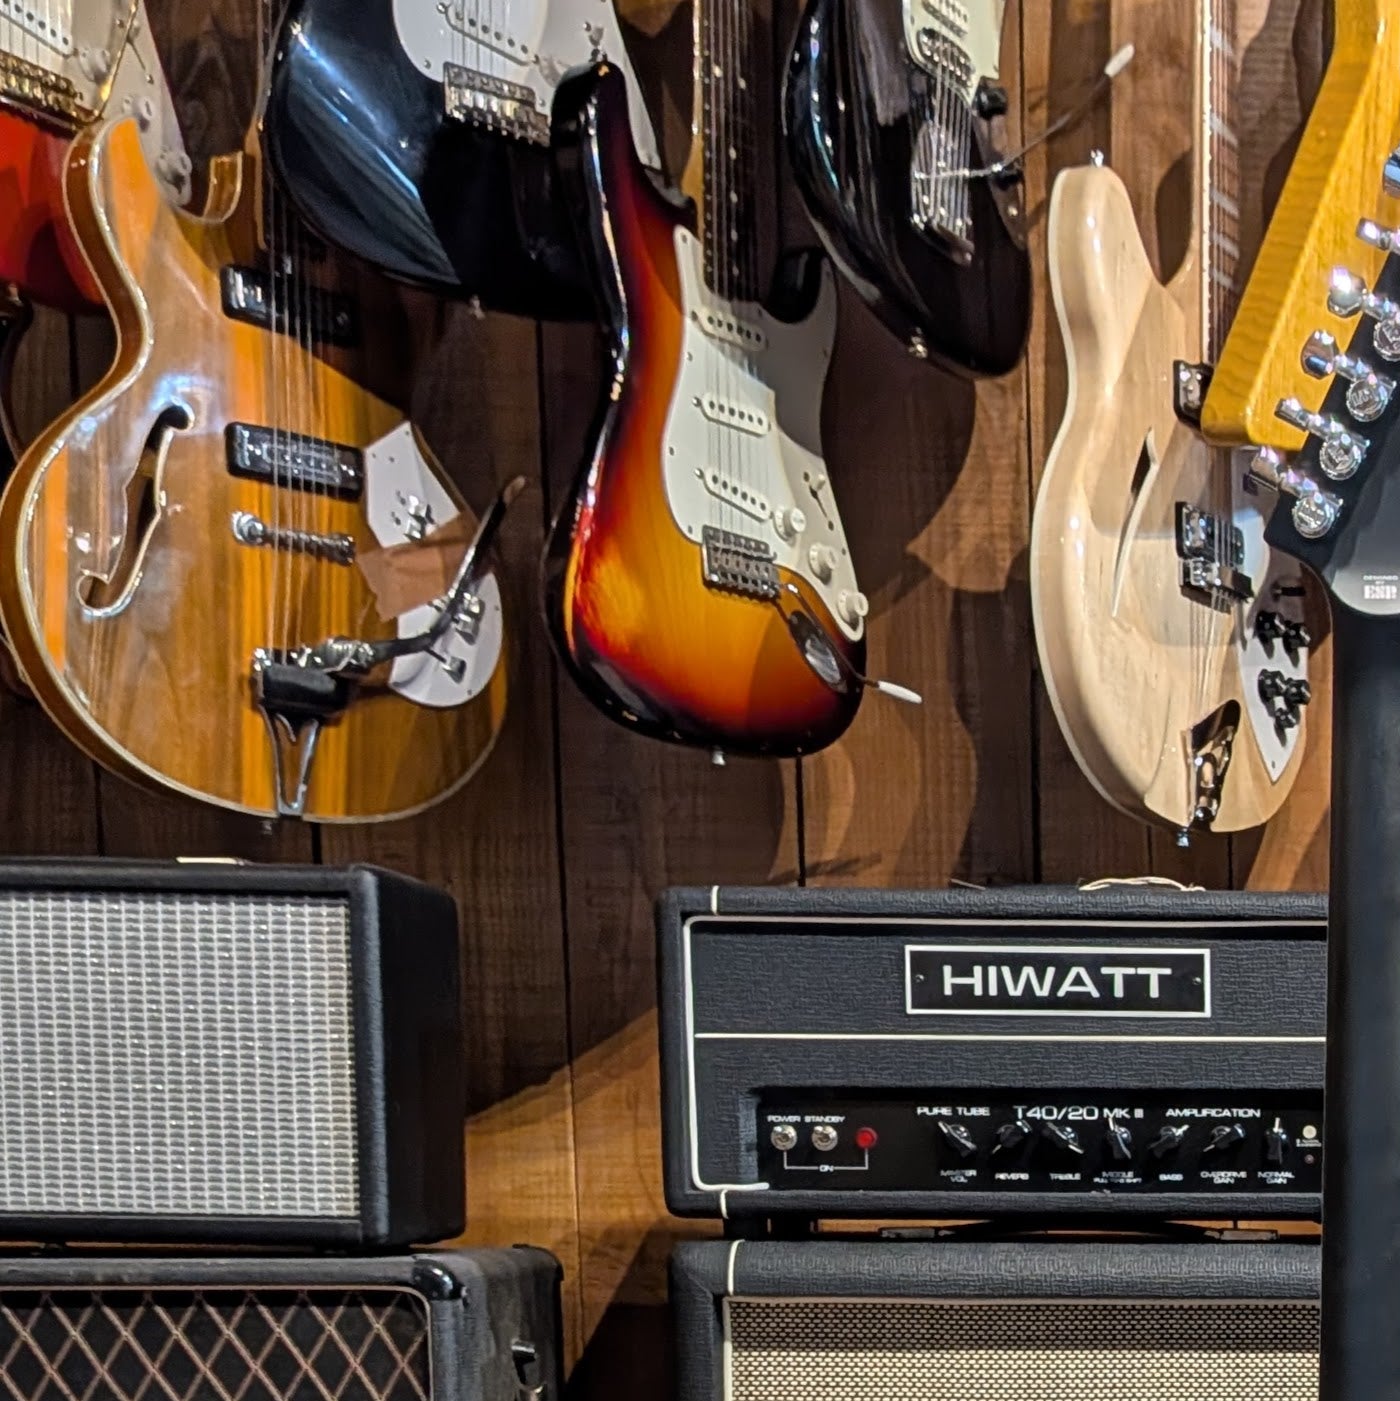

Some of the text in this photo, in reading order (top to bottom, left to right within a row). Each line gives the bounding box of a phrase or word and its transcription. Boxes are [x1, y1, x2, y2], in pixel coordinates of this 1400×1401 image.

[943, 965, 1172, 998] HIWATT
[917, 1106, 991, 1116] PURE TUBE
[1013, 1105, 1099, 1120] T40/20
[1103, 1108, 1130, 1118] MK
[1165, 1108, 1261, 1118] AMPLIFICATION
[767, 1115, 801, 1123] POWER
[804, 1115, 846, 1123] STANDBY
[1159, 1173, 1183, 1181] BASS
